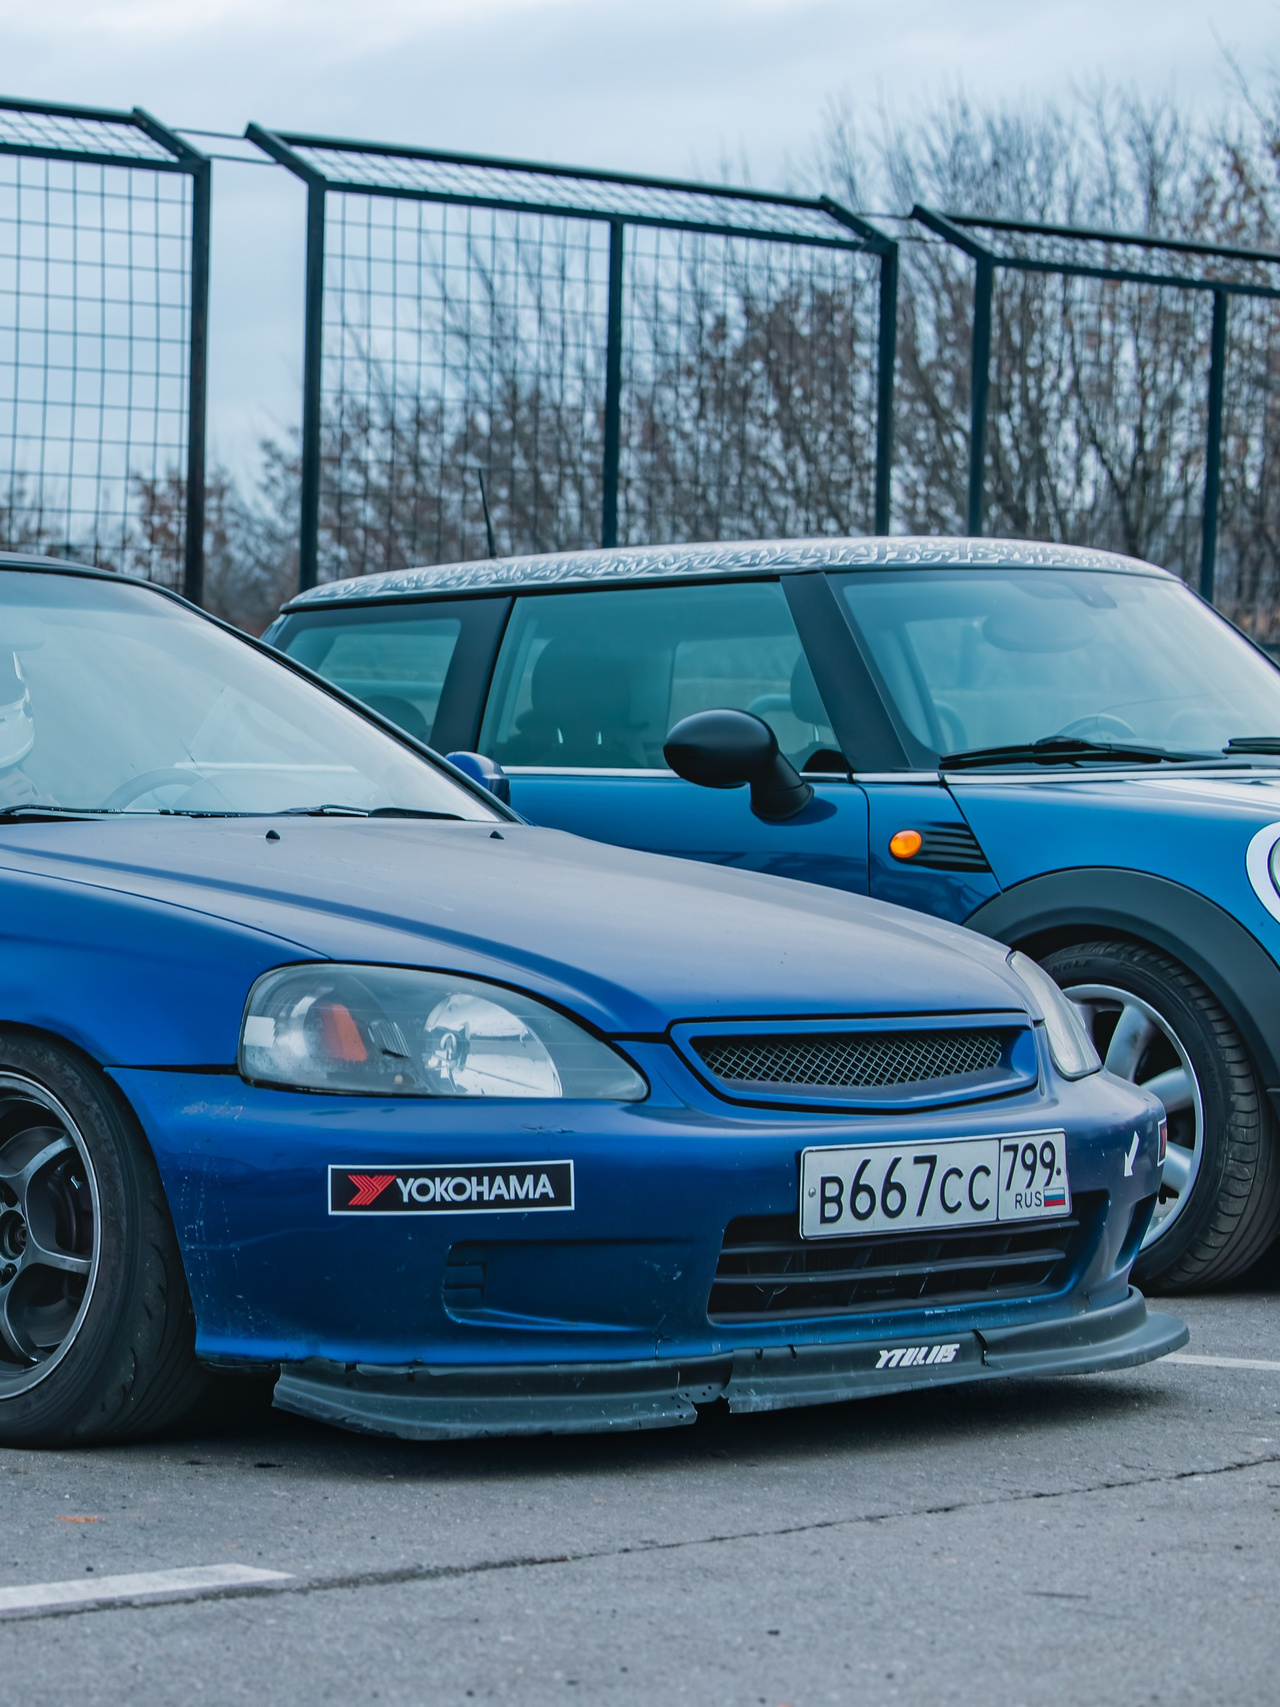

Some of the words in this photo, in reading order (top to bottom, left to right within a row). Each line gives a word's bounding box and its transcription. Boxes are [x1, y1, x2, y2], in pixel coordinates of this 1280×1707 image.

[1002, 1140, 1057, 1192] 799
[395, 1173, 555, 1203] YOKOHAMA
[1014, 1190, 1042, 1210] RUS
